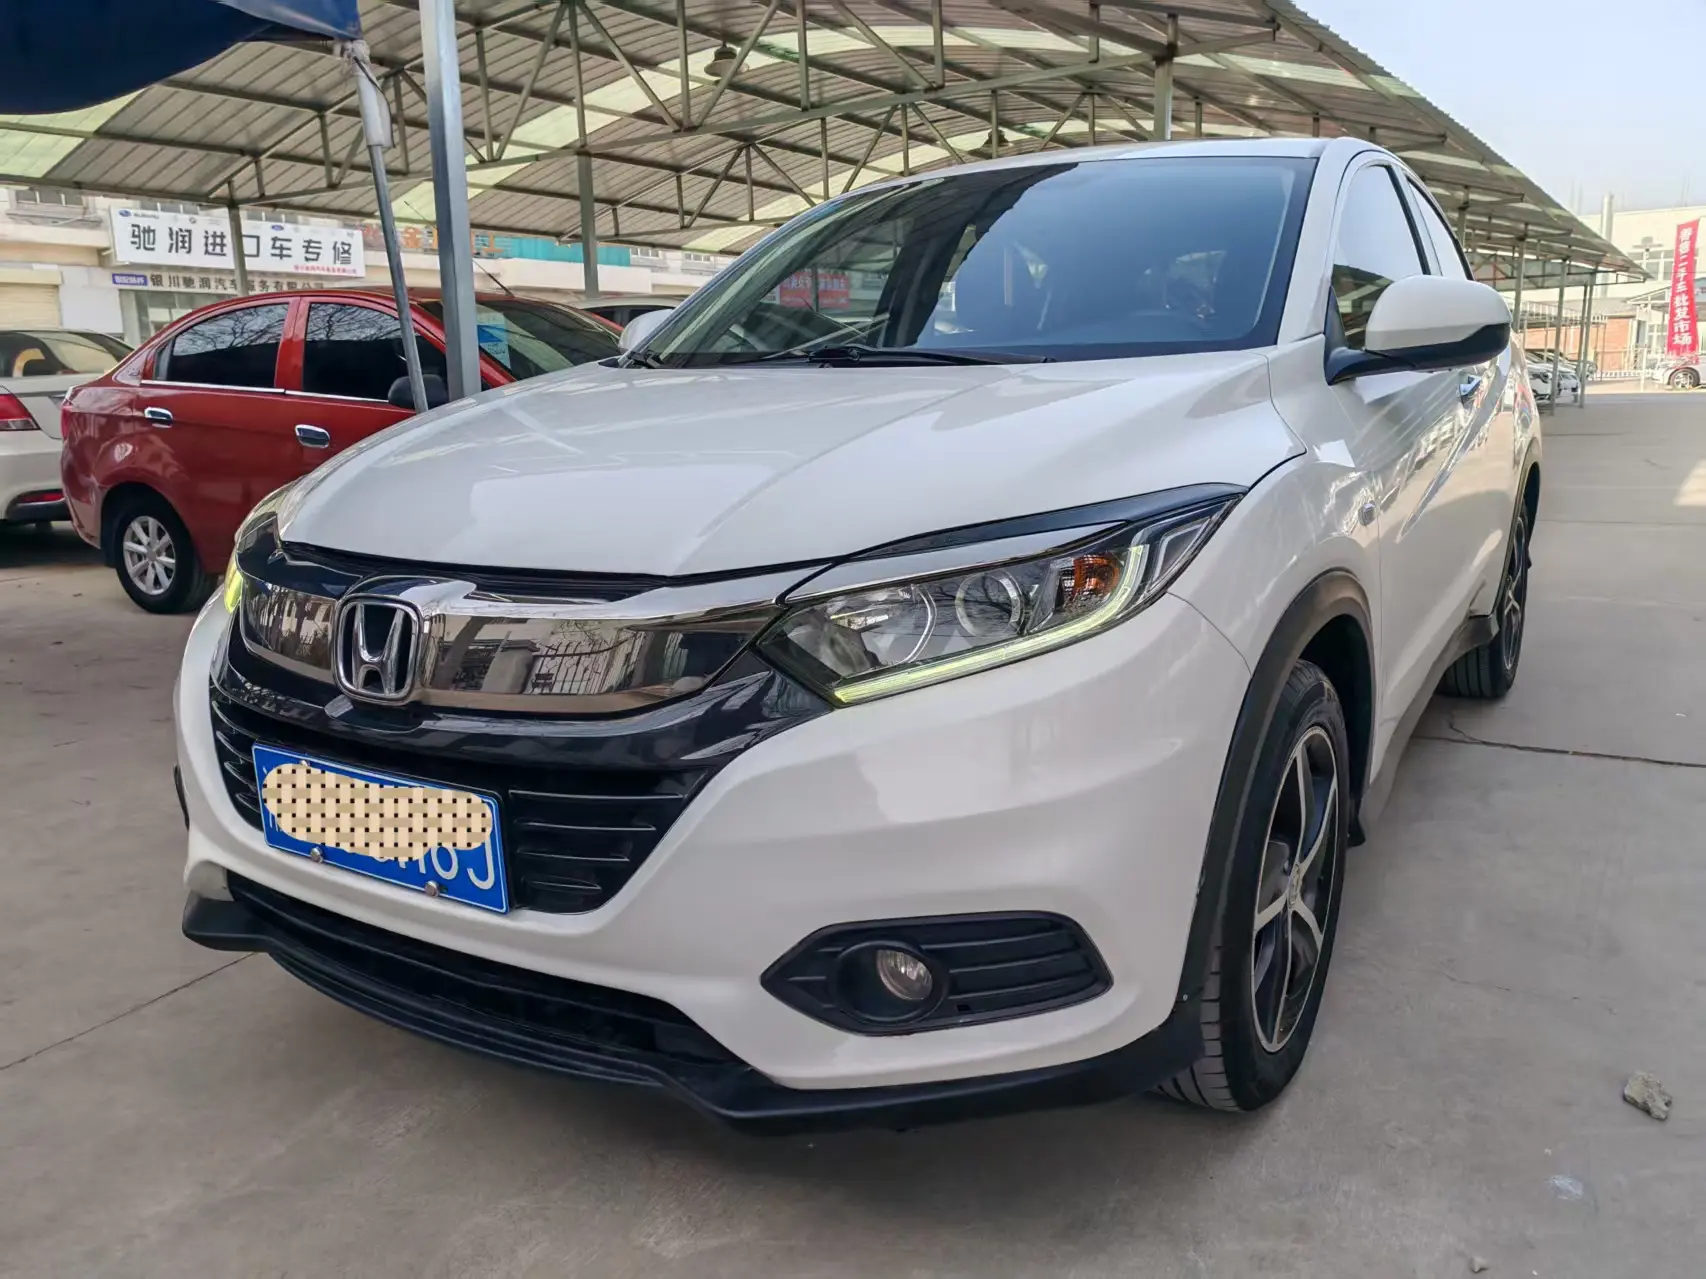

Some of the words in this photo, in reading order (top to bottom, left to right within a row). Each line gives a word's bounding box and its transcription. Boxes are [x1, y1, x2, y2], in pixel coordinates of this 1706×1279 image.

[130, 223, 352, 265] 驰润进口车专修
